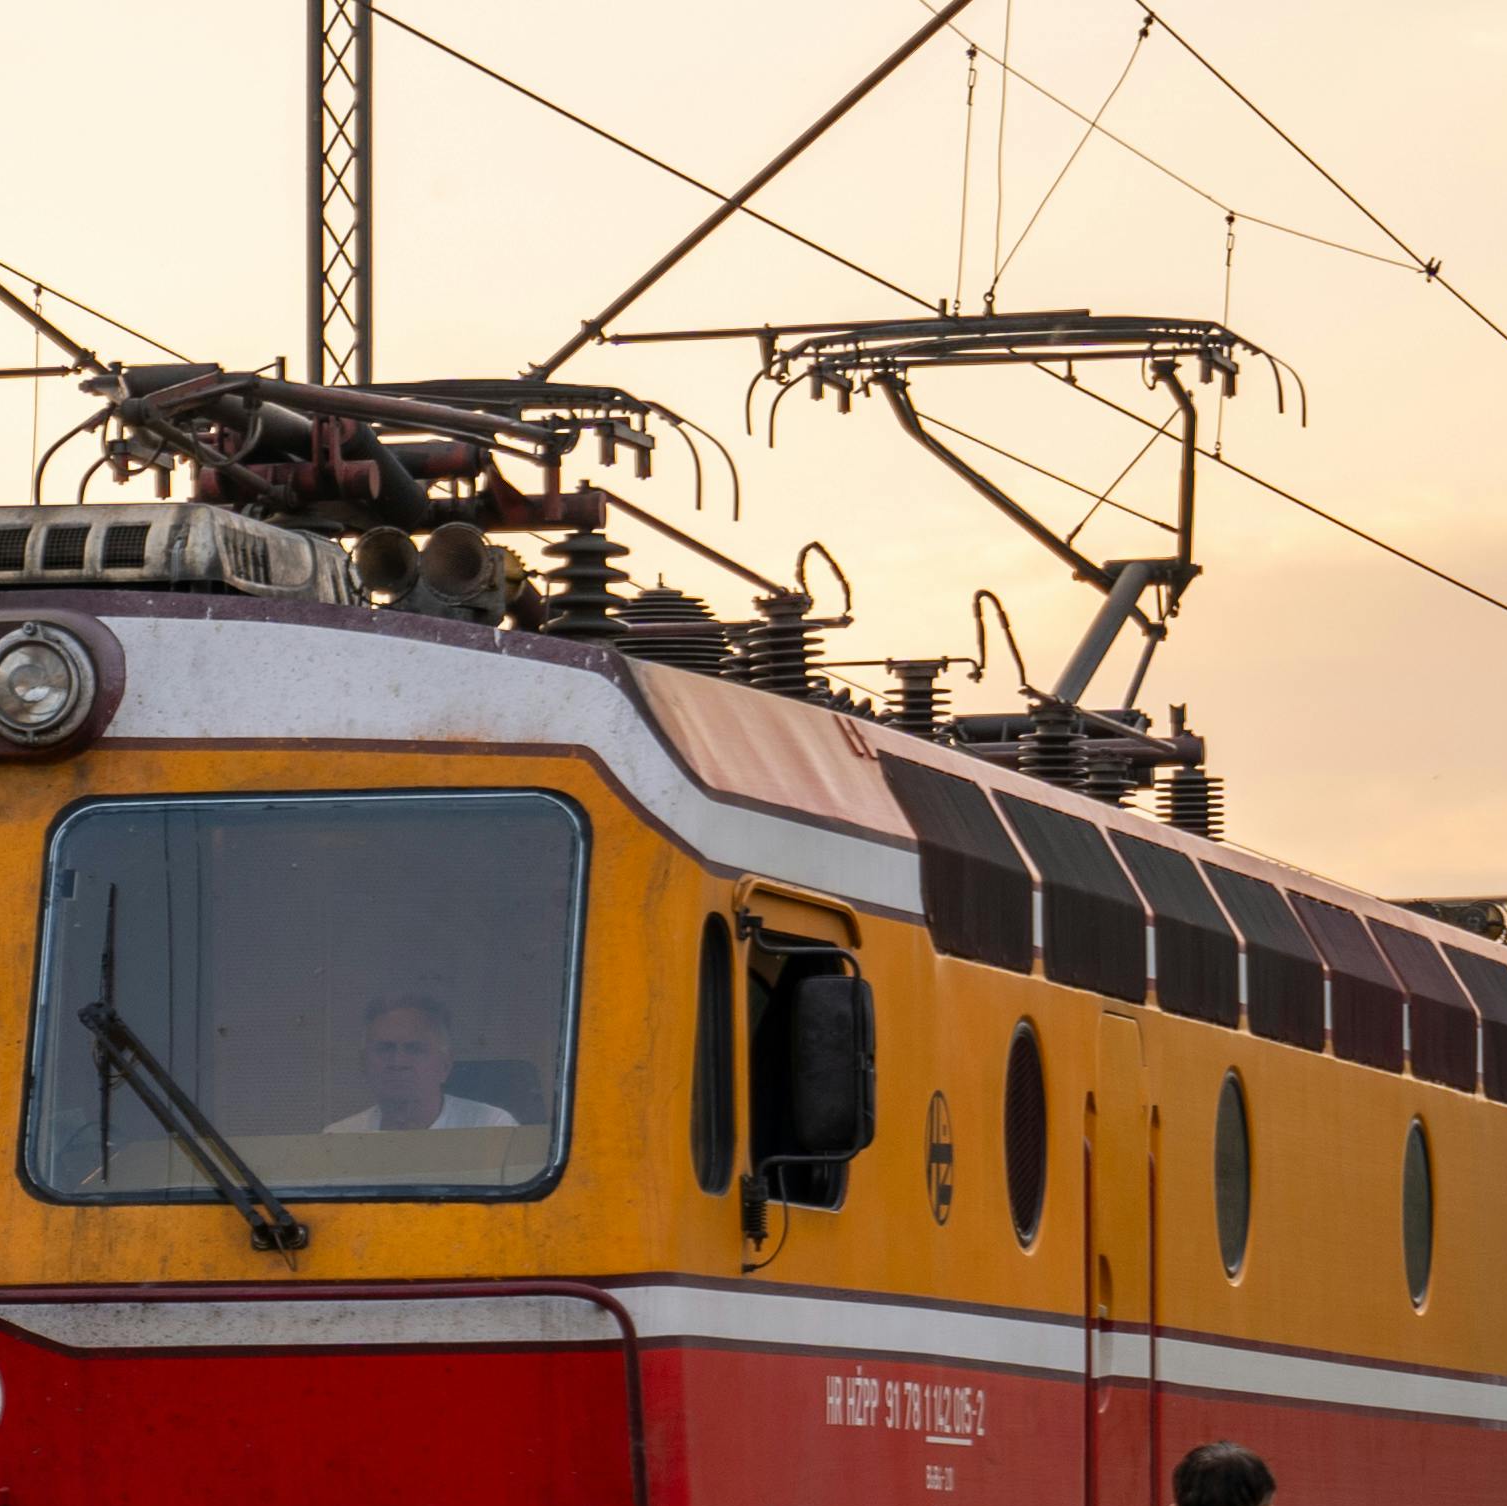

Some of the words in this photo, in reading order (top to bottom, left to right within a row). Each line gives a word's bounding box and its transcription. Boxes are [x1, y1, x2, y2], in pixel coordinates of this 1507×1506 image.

[846, 1365, 879, 1427] HŽPP
[885, 1381, 902, 1429] 91
[903, 1382, 922, 1431] 78
